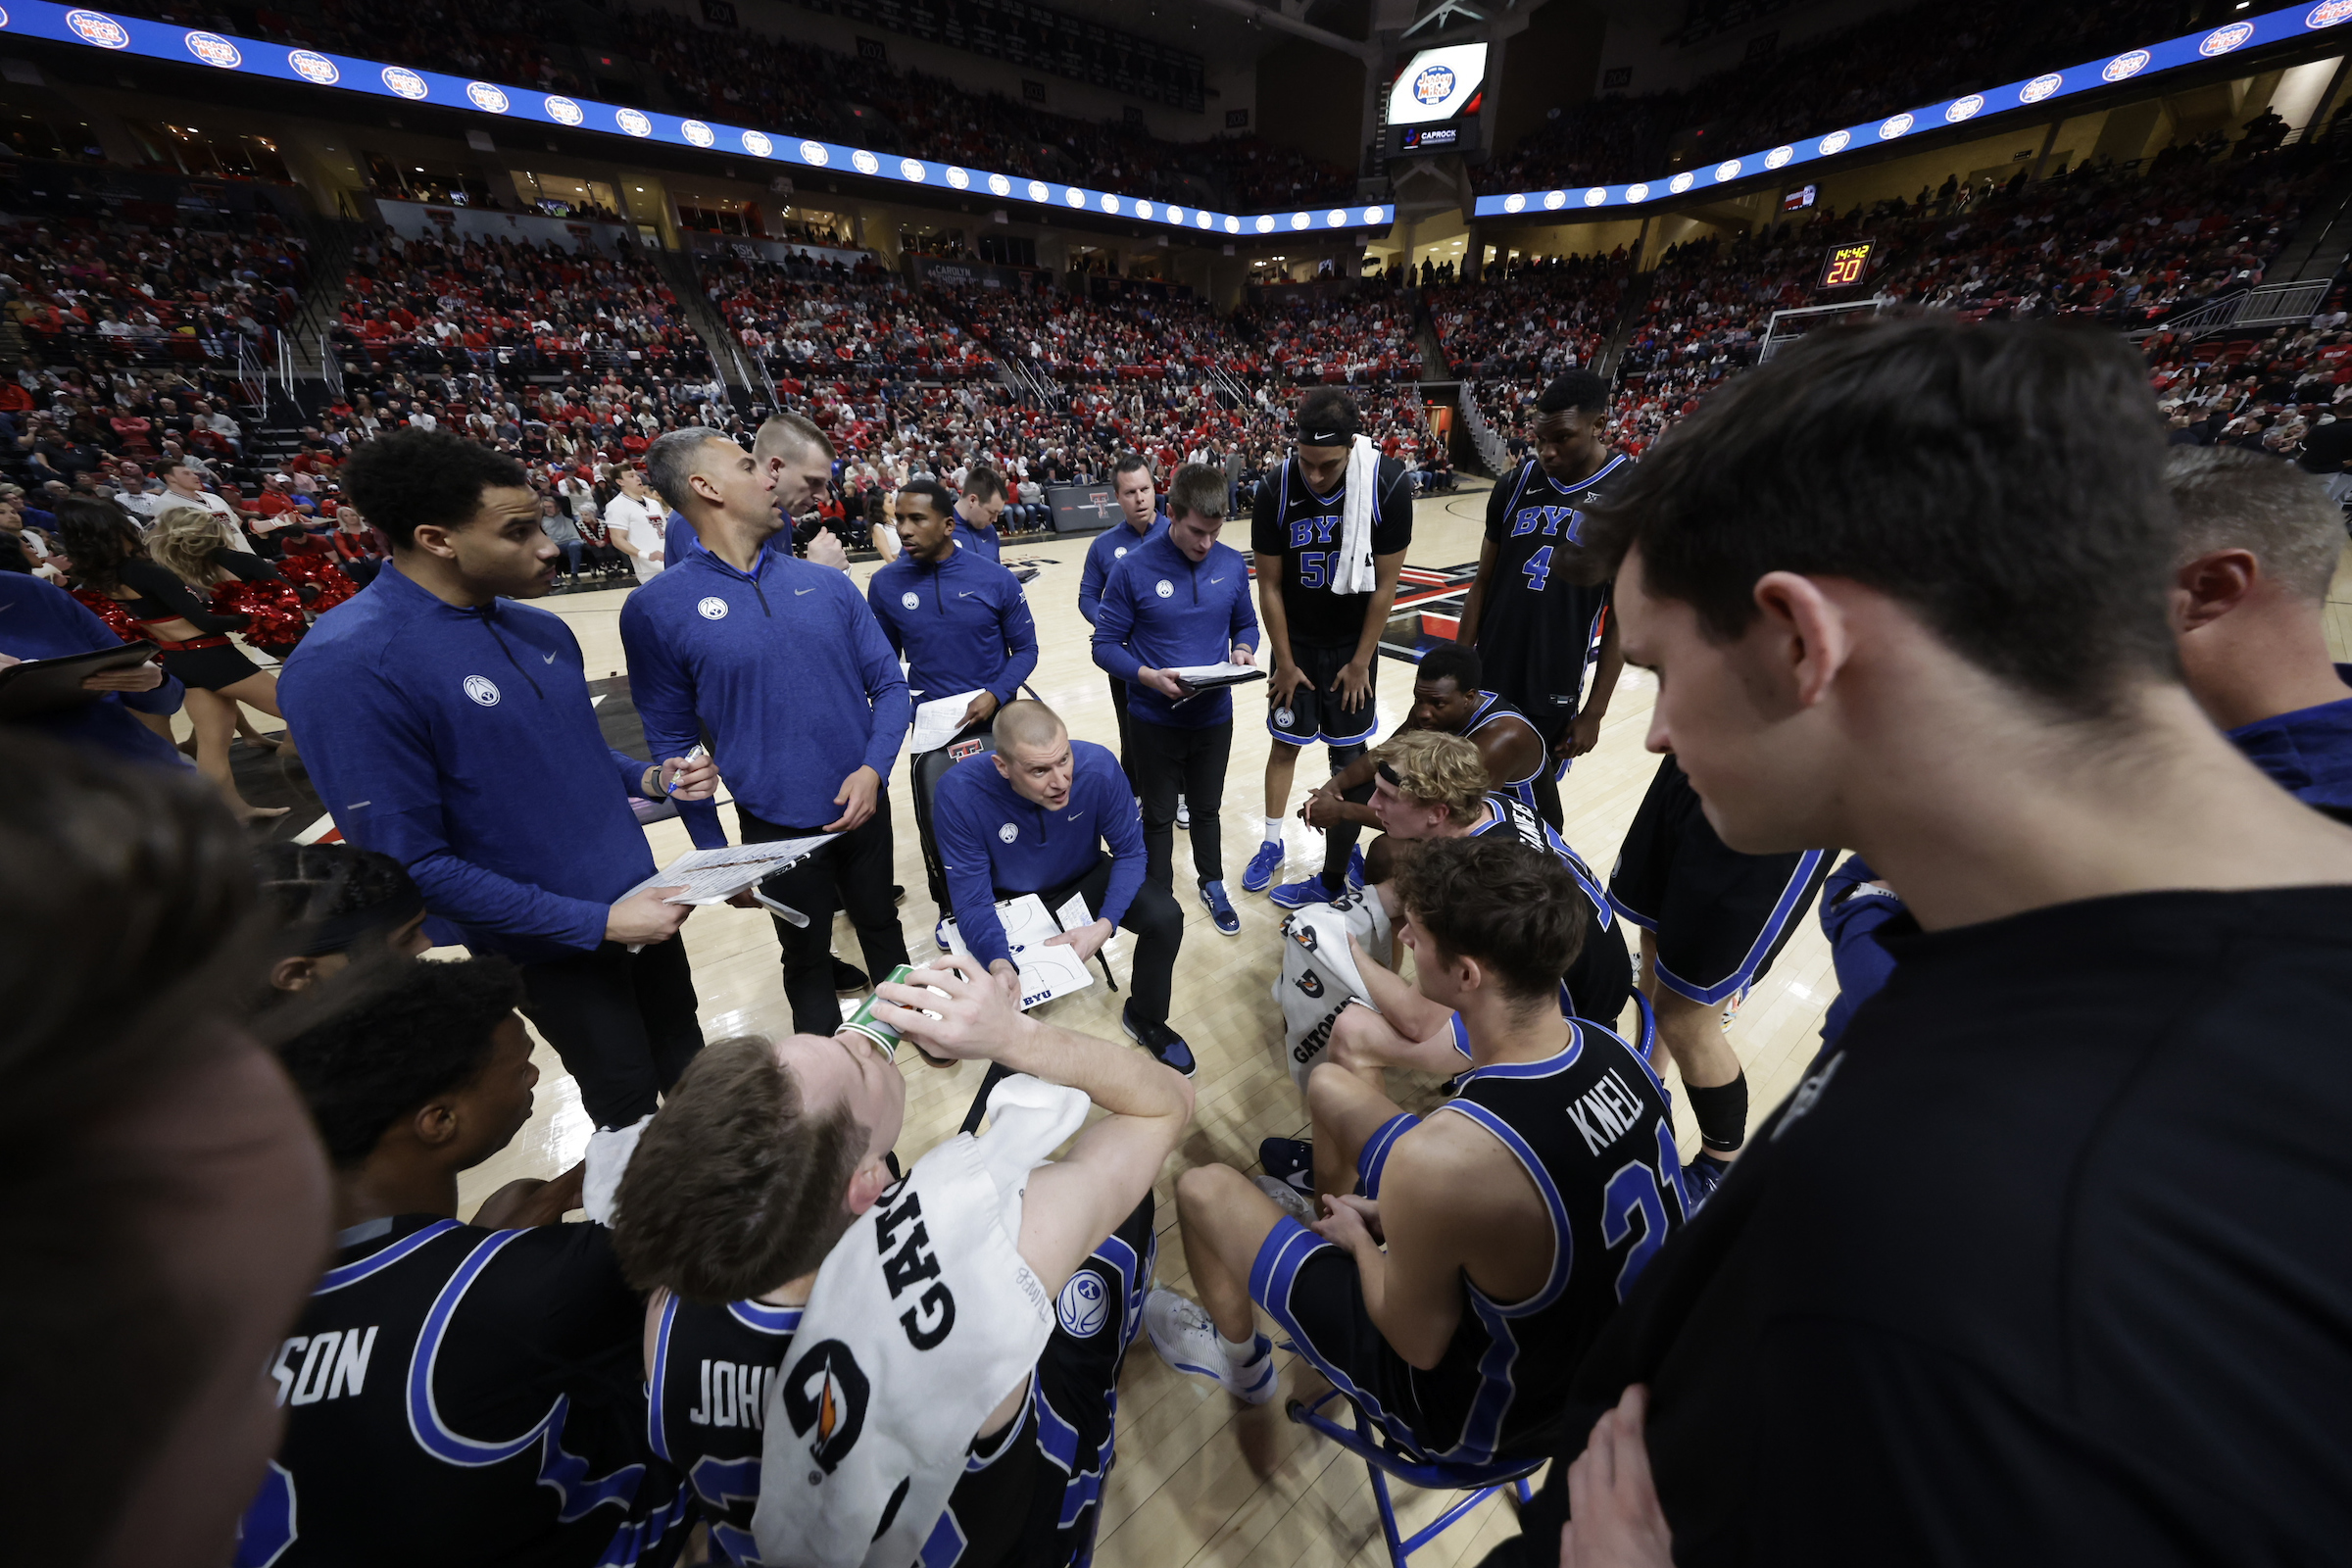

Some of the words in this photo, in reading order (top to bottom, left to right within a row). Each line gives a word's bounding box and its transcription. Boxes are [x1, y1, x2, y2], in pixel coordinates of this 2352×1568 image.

[710, 3, 732, 23] 201
[74, 15, 118, 33] Jersey
[2208, 27, 2249, 42] Jersey
[192, 36, 231, 53] Jersey
[860, 42, 883, 60] 202
[1419, 73, 1452, 84] Jersey
[1421, 129, 1456, 139] CAPROCK
[1835, 245, 1870, 261] 14:42
[935, 265, 971, 276] CAROLYN
[1827, 260, 1861, 284] 20
[1290, 515, 1344, 549] BY
[1522, 545, 1554, 591] 4
[1023, 990, 1053, 1006] BYU
[1566, 1067, 1645, 1157] KNELL
[262, 1326, 380, 1409] SON
